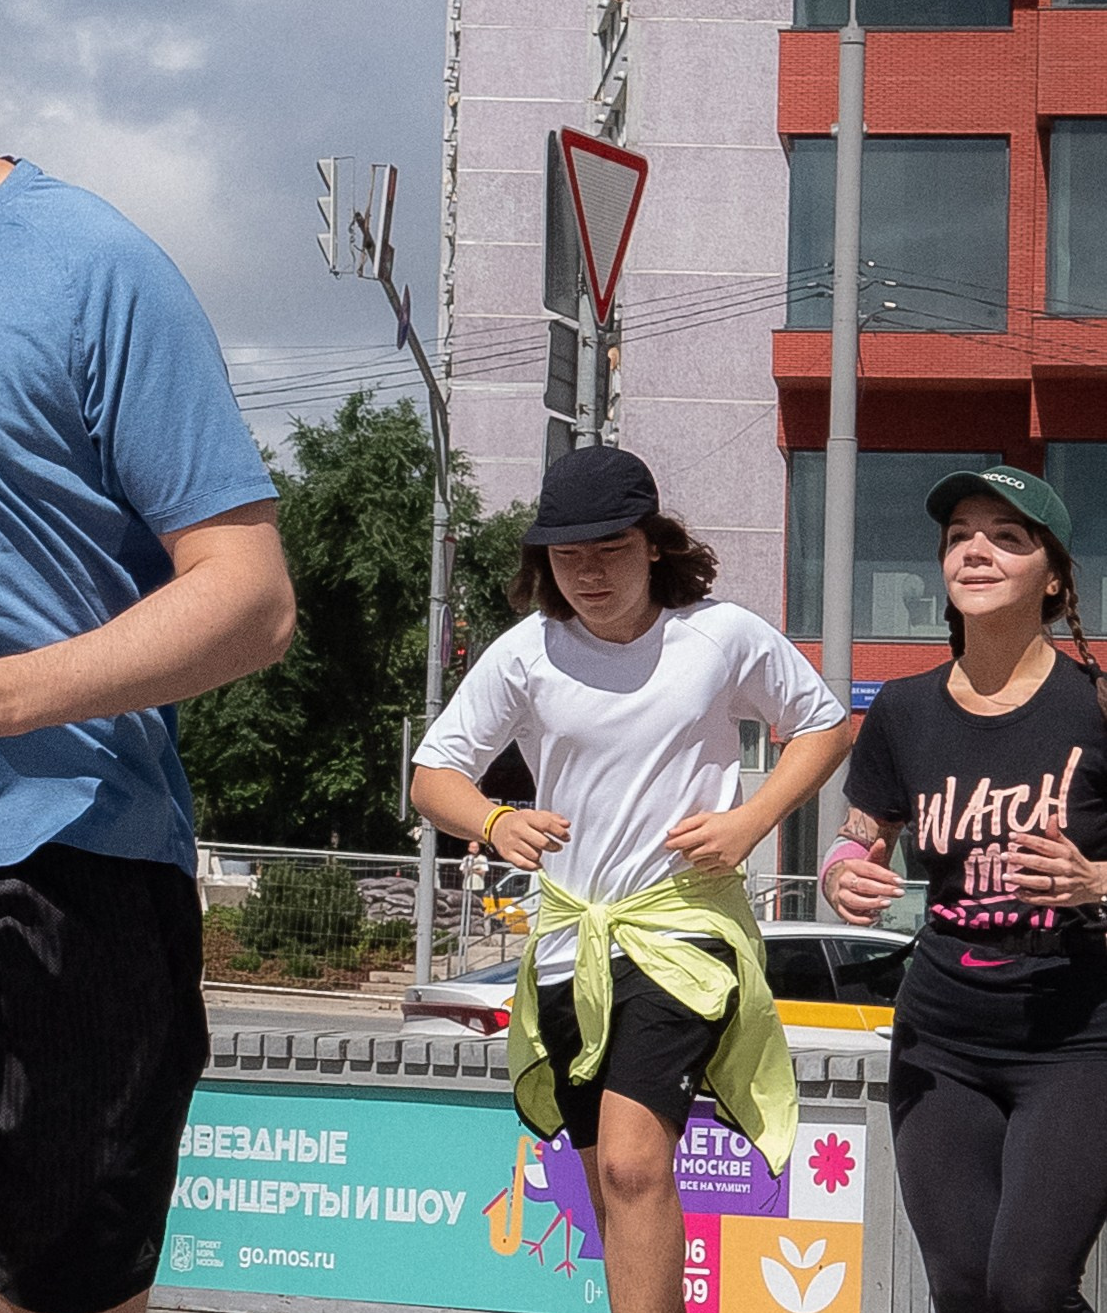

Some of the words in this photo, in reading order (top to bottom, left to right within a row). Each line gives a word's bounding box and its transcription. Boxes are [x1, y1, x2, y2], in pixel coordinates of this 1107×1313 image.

[918, 746, 1083, 855] WATCH
[178, 1124, 349, 1165] ЗВЕЗДНЫЕ
[680, 1158, 752, 1177] МОСКВЕ
[680, 1180, 699, 1191] ВСЕ
[699, 1181, 714, 1192] НА
[715, 1182, 751, 1194] УЛИЦУ!
[171, 1176, 350, 1219] КОНЦЕРТЫ
[355, 1185, 380, 1221] И
[384, 1187, 467, 1226] ШОУ
[239, 1246, 335, 1269] go.mos.ru
[584, 1278, 604, 1304] 0+
